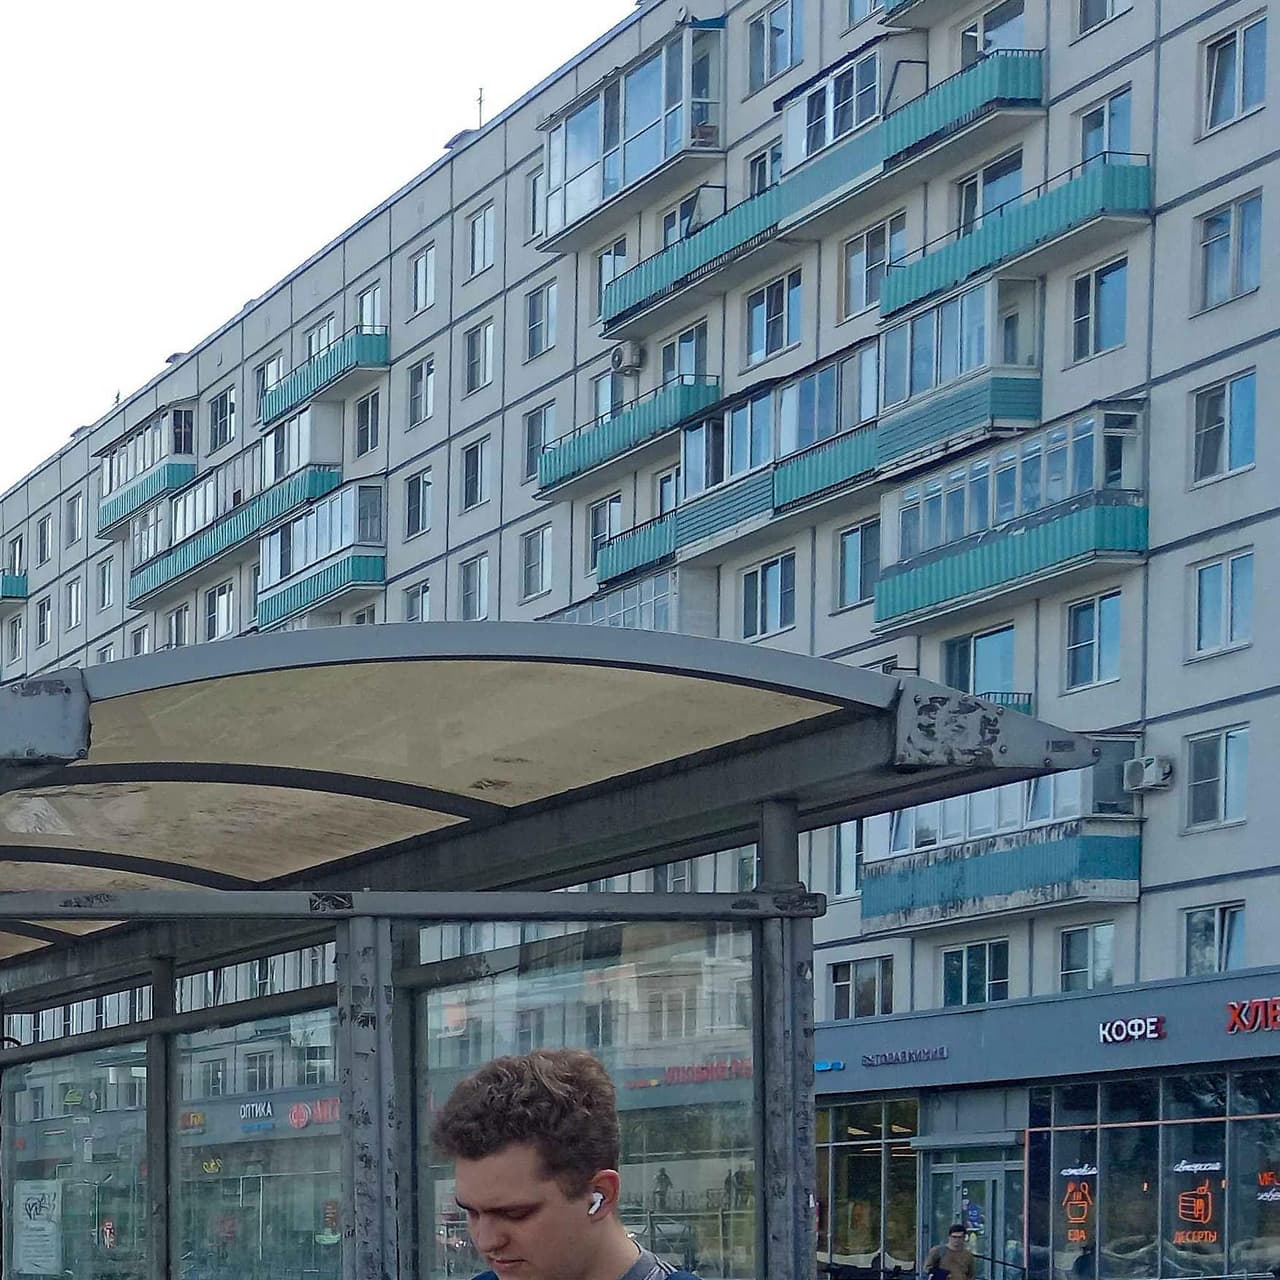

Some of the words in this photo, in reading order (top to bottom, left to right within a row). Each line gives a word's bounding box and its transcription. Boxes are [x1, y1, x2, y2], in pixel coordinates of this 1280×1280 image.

[1099, 1017, 1159, 1043] КОФЕ
[240, 1101, 273, 1119] ОПТИКА
[1173, 1230, 1217, 1244] ДЕСЕРТЫ
